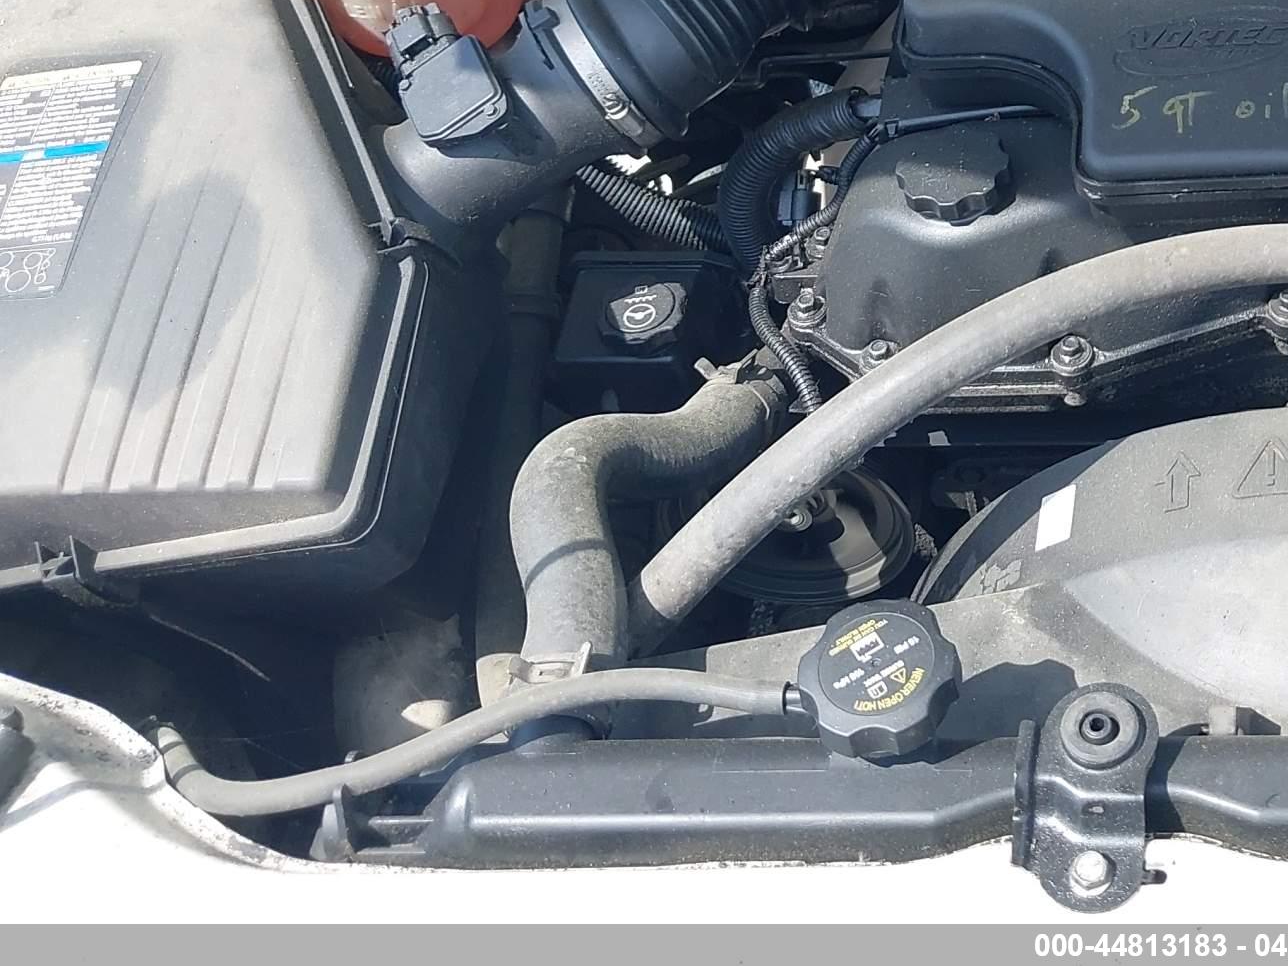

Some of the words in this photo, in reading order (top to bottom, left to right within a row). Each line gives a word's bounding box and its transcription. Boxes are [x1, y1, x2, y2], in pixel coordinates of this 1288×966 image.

[1111, 85, 1159, 130] 5
[858, 619, 876, 632] OPEN
[874, 618, 889, 630] YOU
[899, 667, 925, 696] NEVER
[877, 692, 904, 710] OPEN
